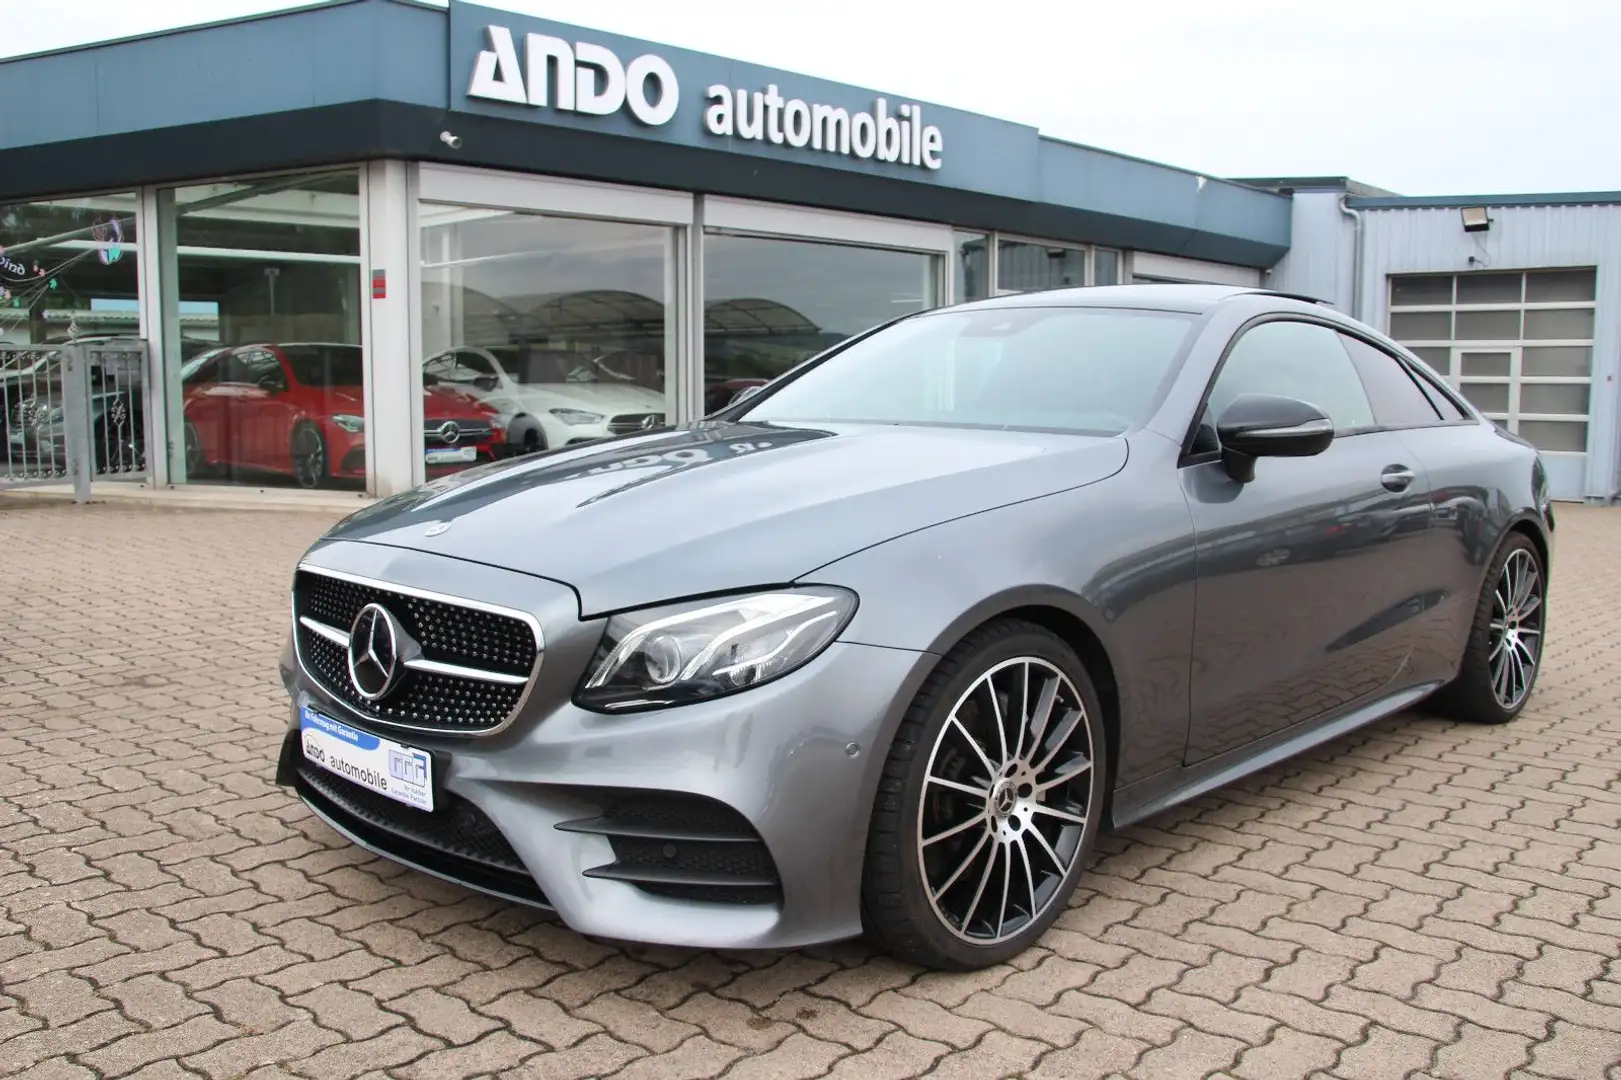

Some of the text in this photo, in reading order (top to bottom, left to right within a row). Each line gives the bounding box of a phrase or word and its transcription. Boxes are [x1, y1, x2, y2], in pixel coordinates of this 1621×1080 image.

[467, 24, 944, 170] ANDO automobile
[330, 755, 388, 790] automobile
